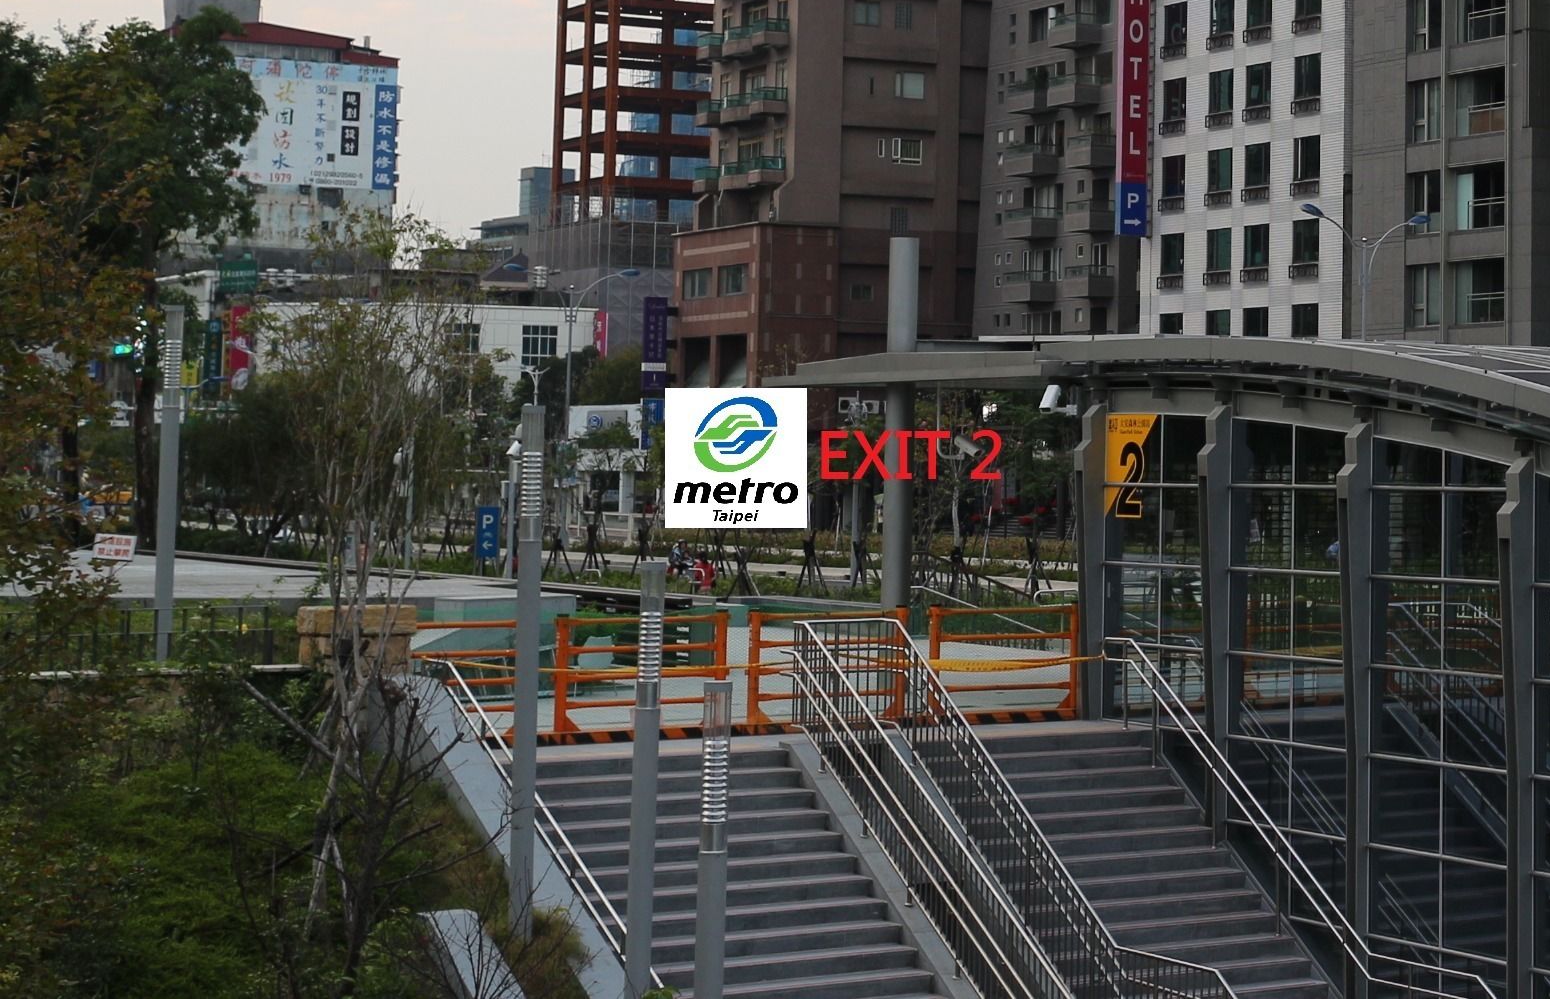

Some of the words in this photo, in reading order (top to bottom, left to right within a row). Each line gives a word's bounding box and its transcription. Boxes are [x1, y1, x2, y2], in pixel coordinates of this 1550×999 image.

[270, 172, 292, 183] 1979
[1127, 192, 1140, 209] P
[1115, 441, 1145, 517] 2
[482, 514, 494, 529] P
